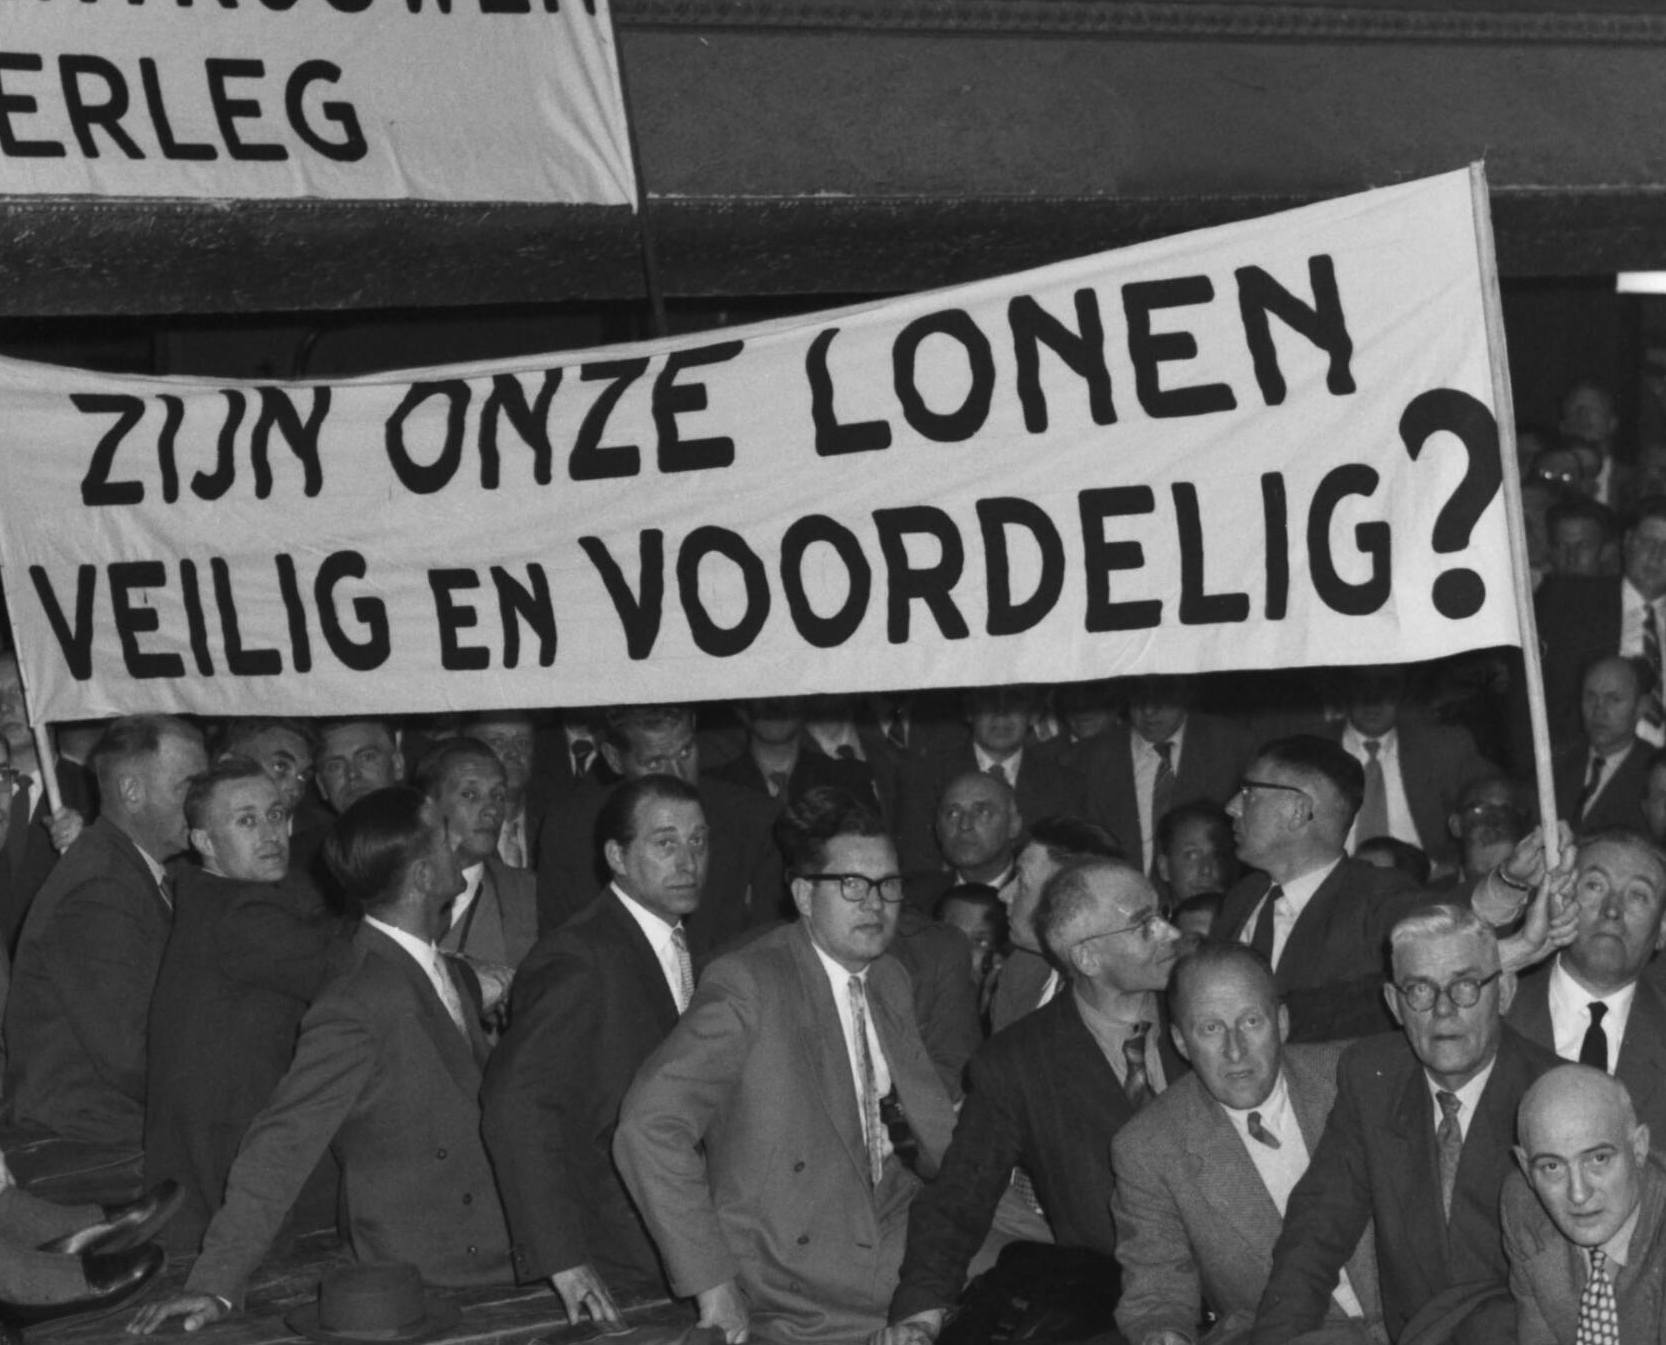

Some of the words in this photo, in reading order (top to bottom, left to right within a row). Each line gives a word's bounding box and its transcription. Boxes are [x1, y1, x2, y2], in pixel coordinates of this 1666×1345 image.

[68, 385, 332, 507] ZIJN
[385, 339, 746, 495] ONZE
[805, 254, 1356, 457] LONEN
[28, 550, 391, 682] VEILIG
[427, 562, 558, 671] EN
